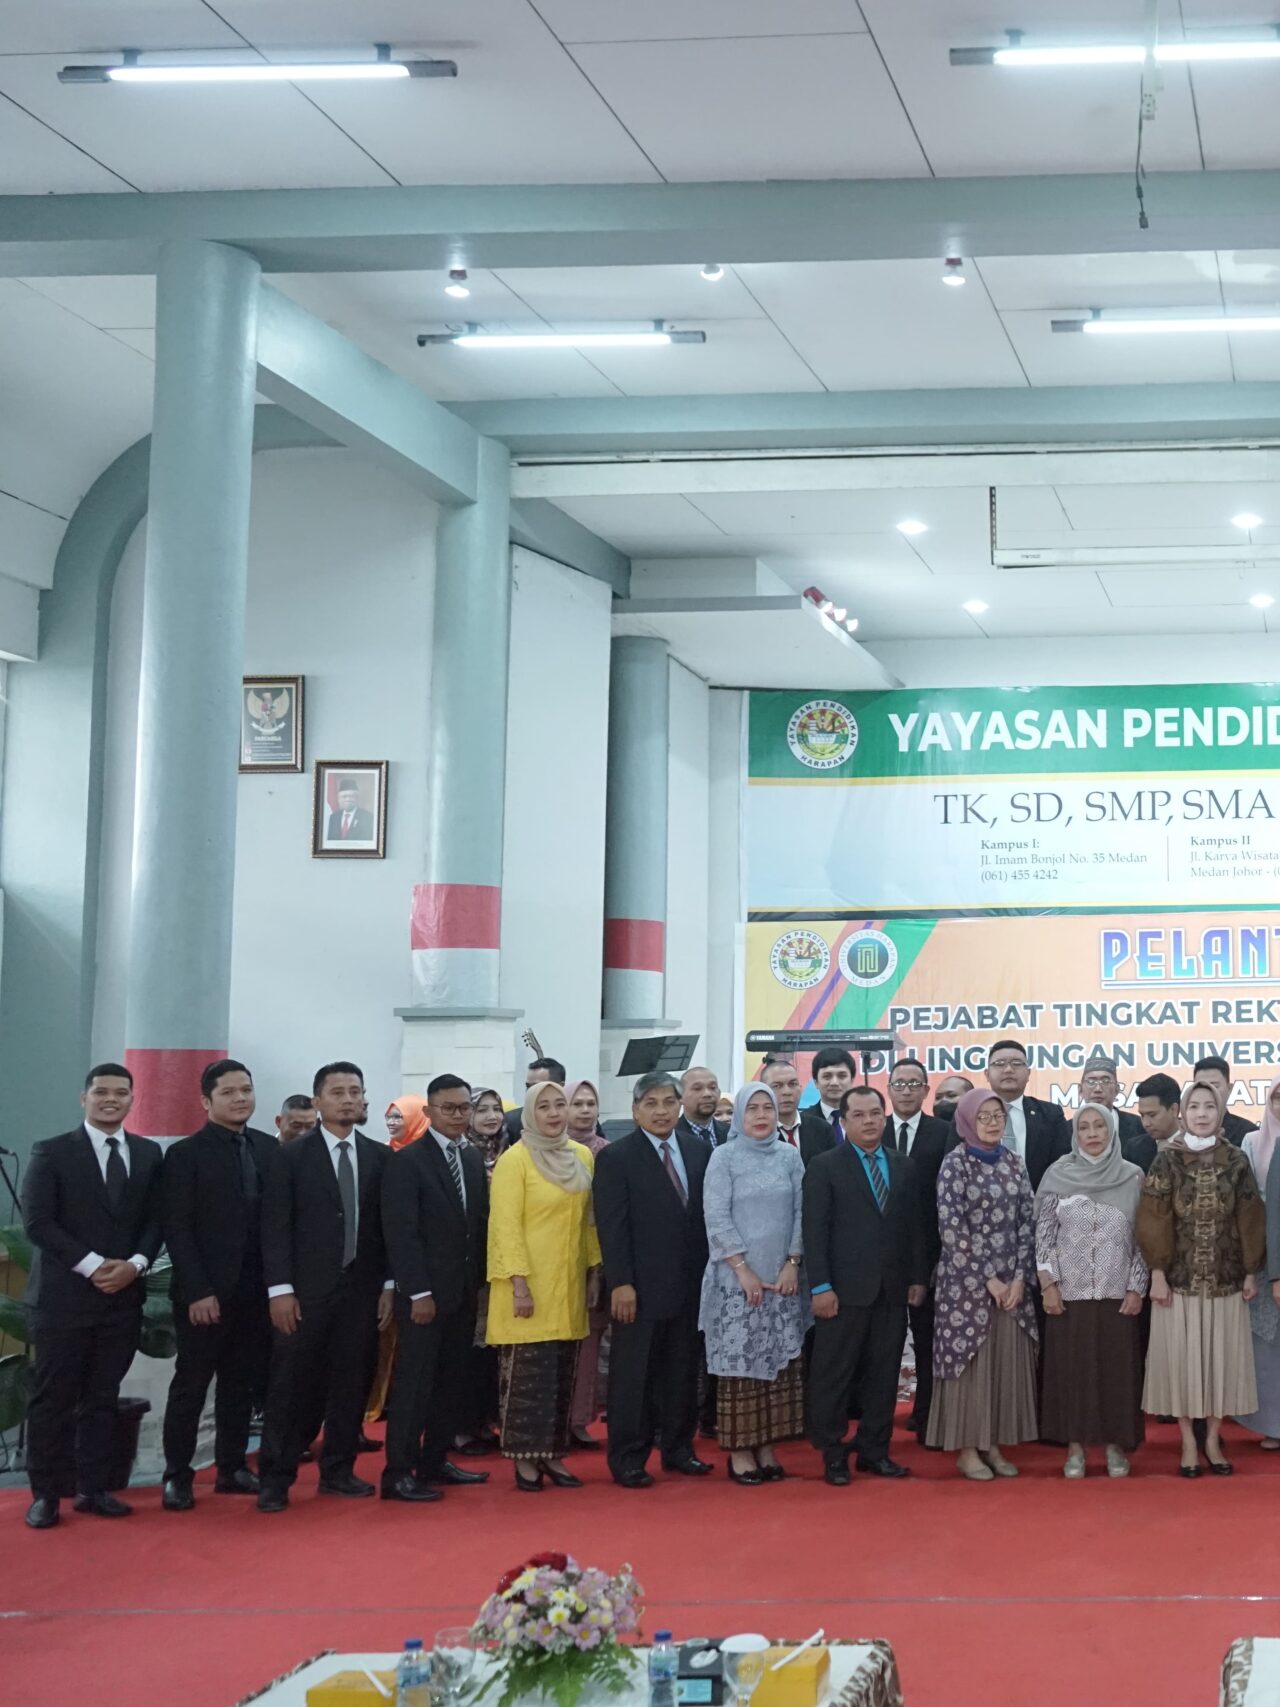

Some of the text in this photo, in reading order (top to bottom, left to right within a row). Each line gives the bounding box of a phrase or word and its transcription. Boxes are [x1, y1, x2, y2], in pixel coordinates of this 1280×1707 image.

[788, 701, 857, 746] YAYASAN PENDIDIKAN
[888, 709, 1107, 752] YAYASAN
[800, 755, 844, 768] HARAPAN
[934, 793, 998, 828] TK,
[1010, 792, 1073, 827] SD,
[1085, 790, 1174, 826] SMP,
[1183, 789, 1275, 820] SMA
[981, 838, 1040, 852] Kampus I:
[1191, 836, 1238, 848] Kampus
[995, 855, 1028, 865] Imam
[1031, 854, 1066, 866] Bonjol
[1069, 854, 1089, 864] No.
[1092, 853, 1105, 863] 35
[1109, 852, 1148, 863] Medan
[1241, 850, 1279, 860] Wisata
[981, 869, 1059, 883] (061) 455 4242
[1191, 867, 1229, 878] Medan
[1233, 866, 1262, 878] Johor
[772, 935, 792, 970] YAYASAN
[889, 1004, 1043, 1032] PEJABAT
[1053, 1001, 1199, 1028] TINGKAT
